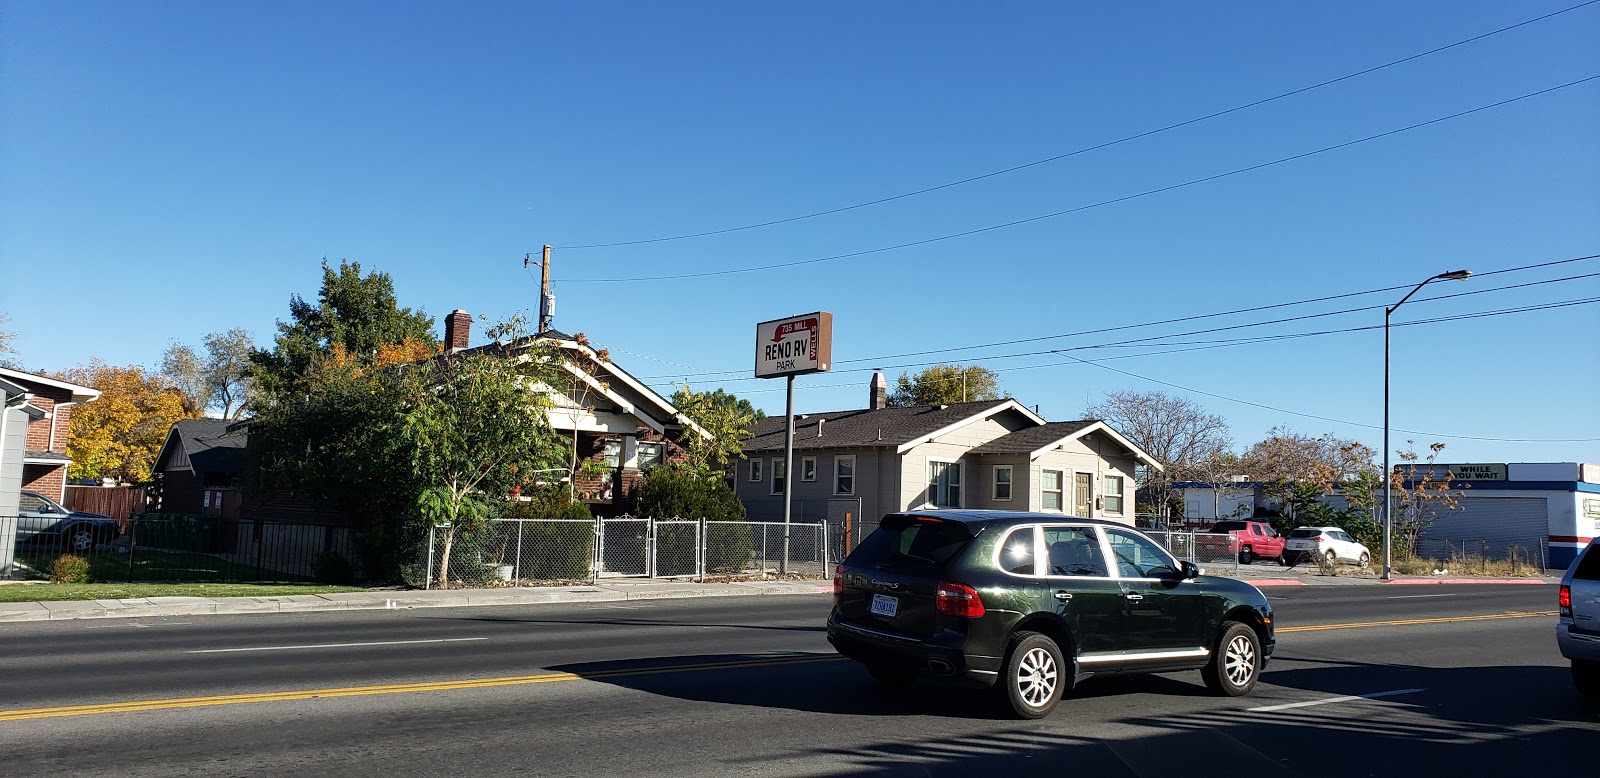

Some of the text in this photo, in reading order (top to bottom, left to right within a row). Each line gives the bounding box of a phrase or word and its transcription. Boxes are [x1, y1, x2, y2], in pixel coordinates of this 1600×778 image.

[782, 321, 808, 333] 735 MILL
[765, 339, 808, 361] RENO RV
[776, 359, 796, 371] PARK
